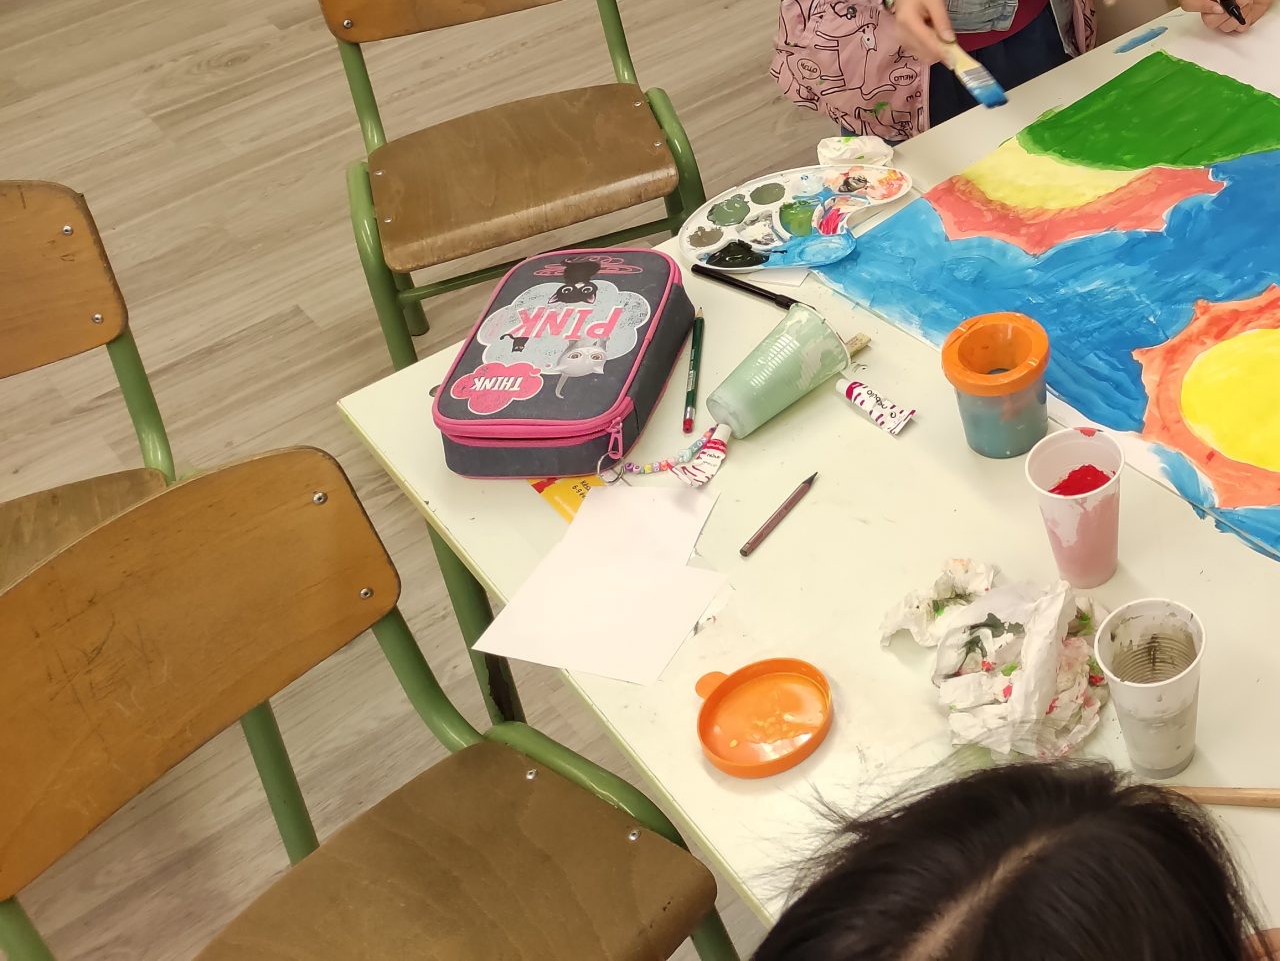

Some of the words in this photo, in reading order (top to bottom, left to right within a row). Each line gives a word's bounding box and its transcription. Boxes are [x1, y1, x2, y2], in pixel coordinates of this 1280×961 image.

[894, 74, 914, 82] HELLO
[510, 305, 624, 341] PINK
[470, 375, 523, 392] THINK
